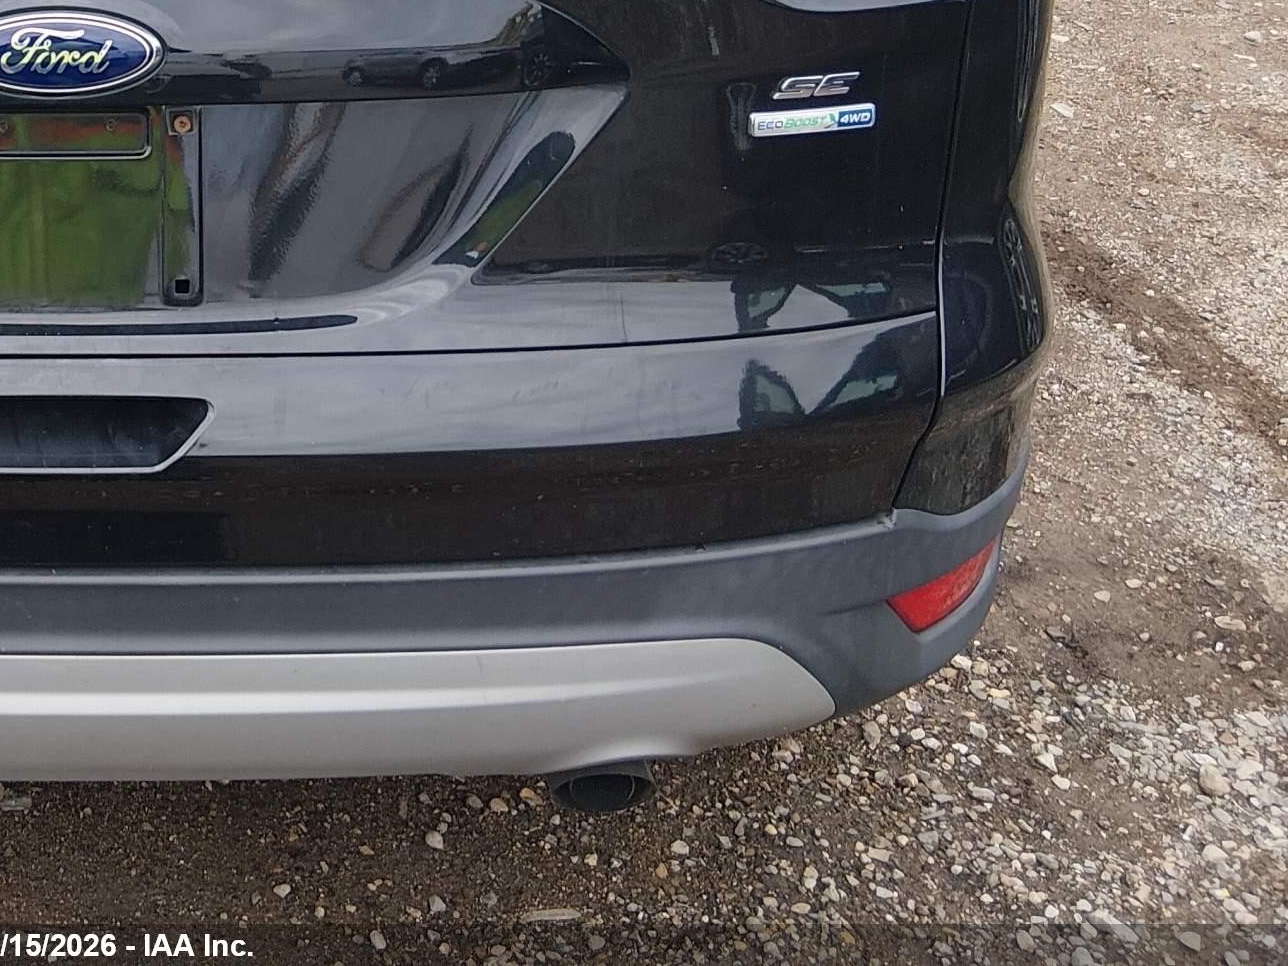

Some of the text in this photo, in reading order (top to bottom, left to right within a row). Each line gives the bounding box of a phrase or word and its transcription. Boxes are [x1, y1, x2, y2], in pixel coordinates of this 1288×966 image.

[0, 27, 113, 75] Ford
[772, 71, 860, 100] SE
[839, 112, 872, 125] 4WD
